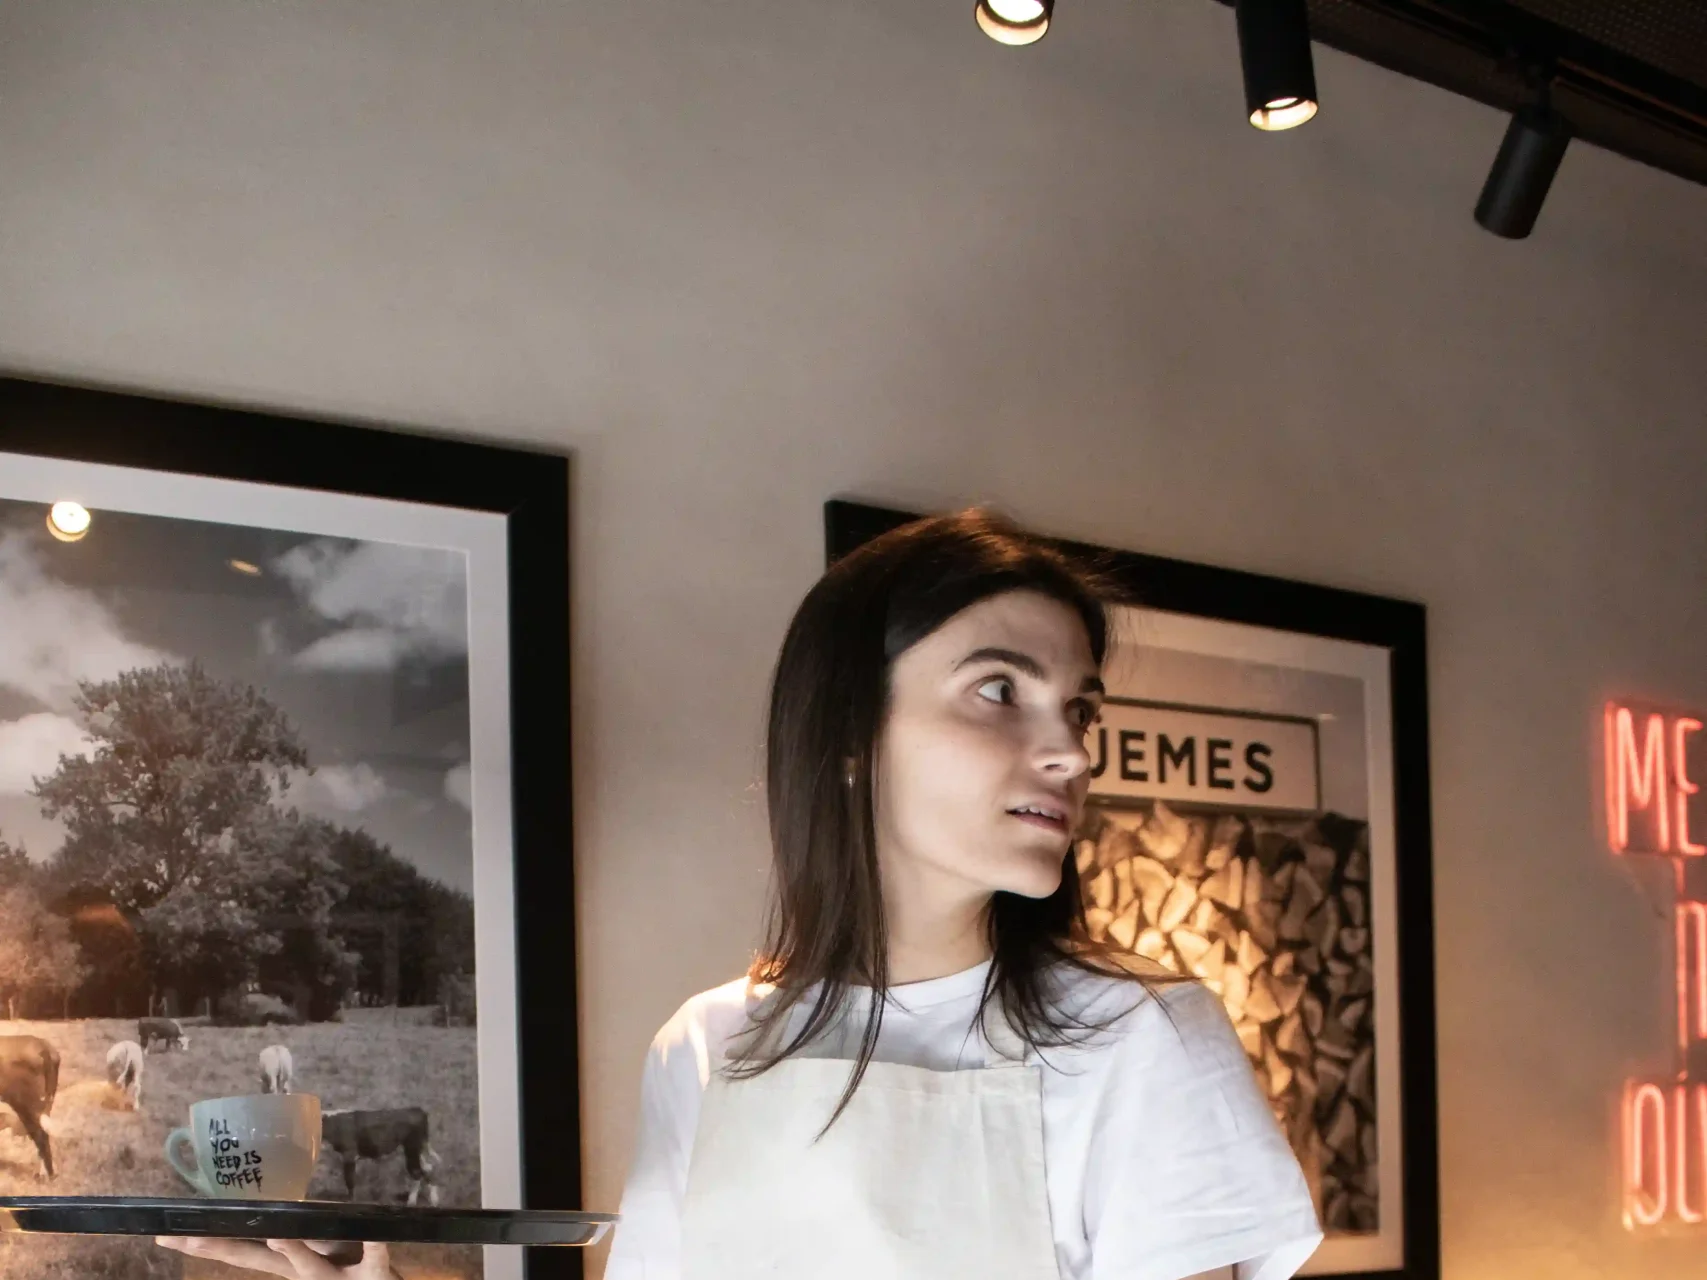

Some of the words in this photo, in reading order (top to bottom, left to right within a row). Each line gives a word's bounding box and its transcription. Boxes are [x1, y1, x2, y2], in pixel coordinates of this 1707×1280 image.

[209, 1118, 231, 1136] ALL
[211, 1137, 240, 1153] YOU
[212, 1154, 242, 1171] NEED
[244, 1150, 262, 1166] IS
[216, 1167, 263, 1193] COFFEE
